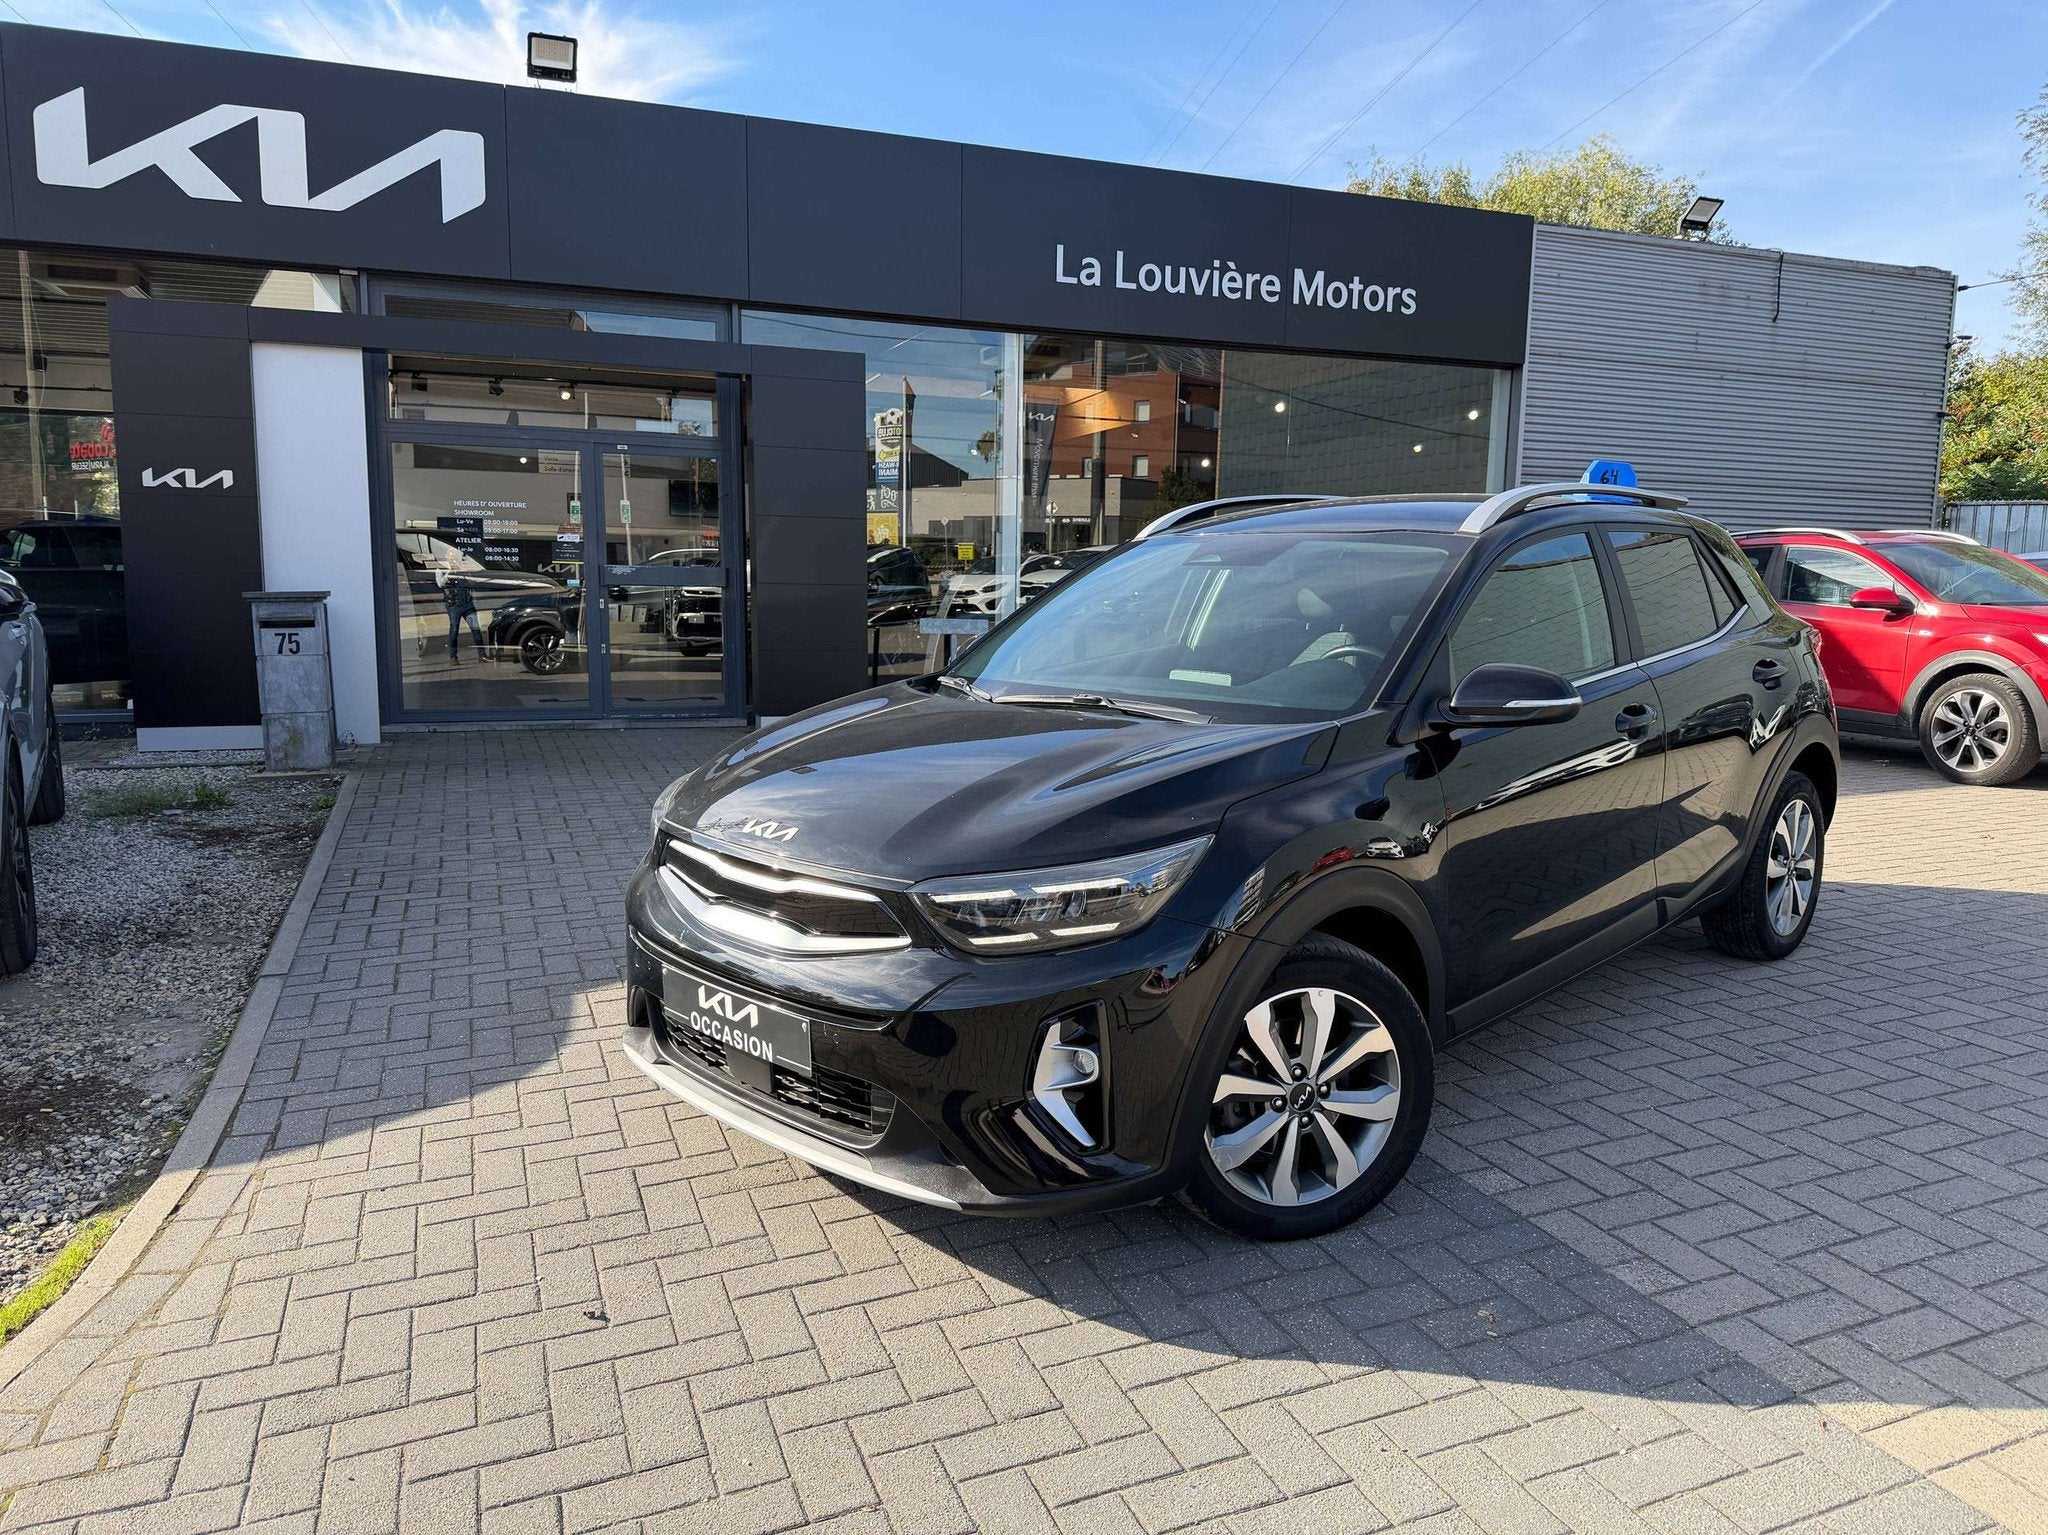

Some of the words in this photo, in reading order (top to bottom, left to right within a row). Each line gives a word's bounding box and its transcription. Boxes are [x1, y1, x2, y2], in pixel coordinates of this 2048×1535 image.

[33, 86, 486, 224] KIA
[1055, 244, 1101, 287] La
[1115, 250, 1281, 303] Louvière
[1292, 268, 1417, 316] Motors
[142, 467, 234, 490] KIA
[1601, 469, 1619, 485] 64
[488, 501, 527, 509] OUVERTURE
[274, 632, 301, 655] 75
[742, 818, 800, 843] KIA
[697, 984, 759, 1029] KIA
[690, 1010, 773, 1063] OCCASION
